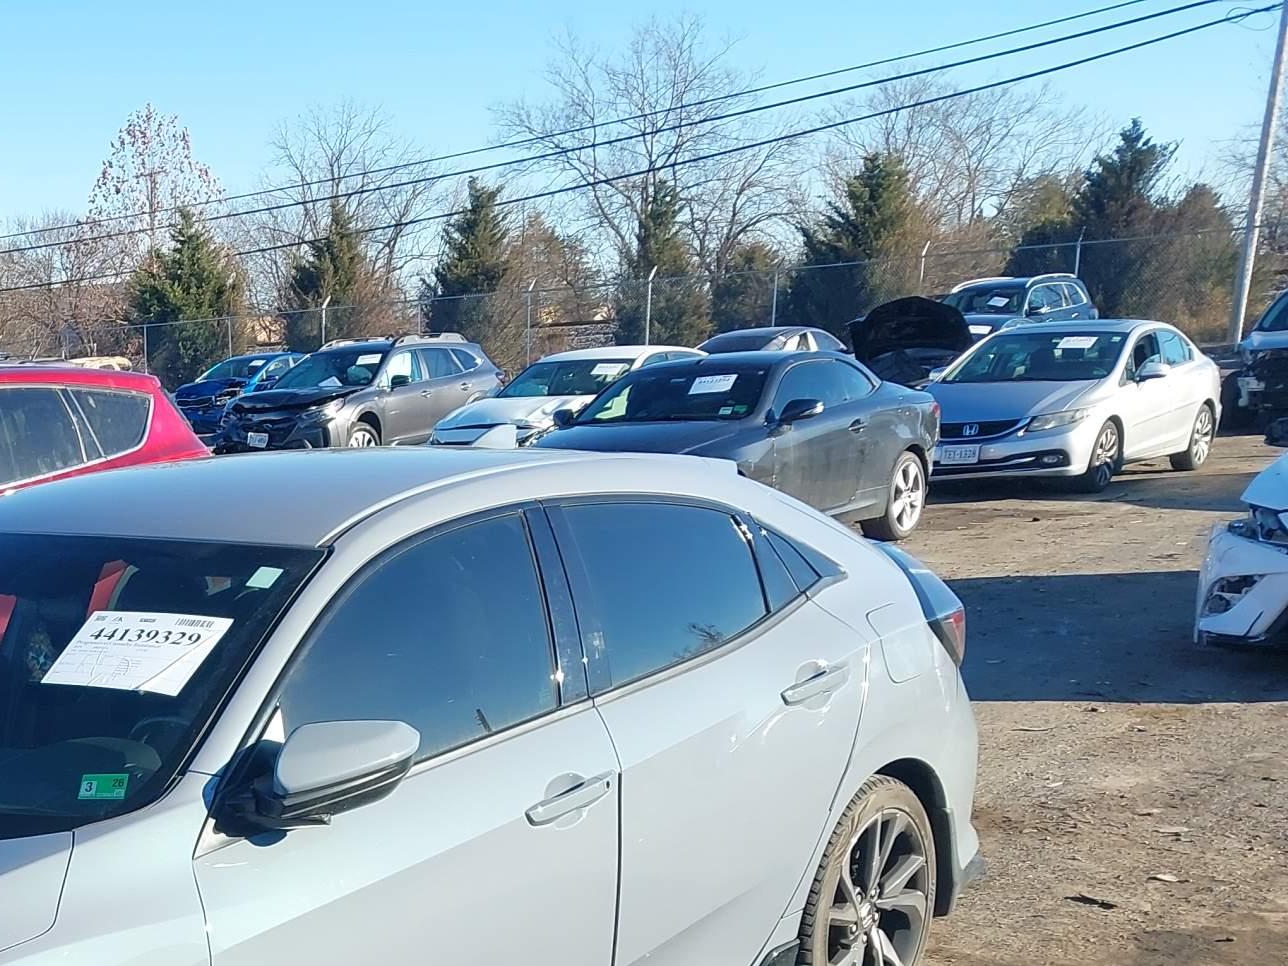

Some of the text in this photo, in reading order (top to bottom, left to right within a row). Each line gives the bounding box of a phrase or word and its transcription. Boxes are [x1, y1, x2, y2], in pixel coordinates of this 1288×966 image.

[89, 627, 201, 646] 44139329
[84, 781, 93, 793] 3
[112, 778, 124, 788] 26
